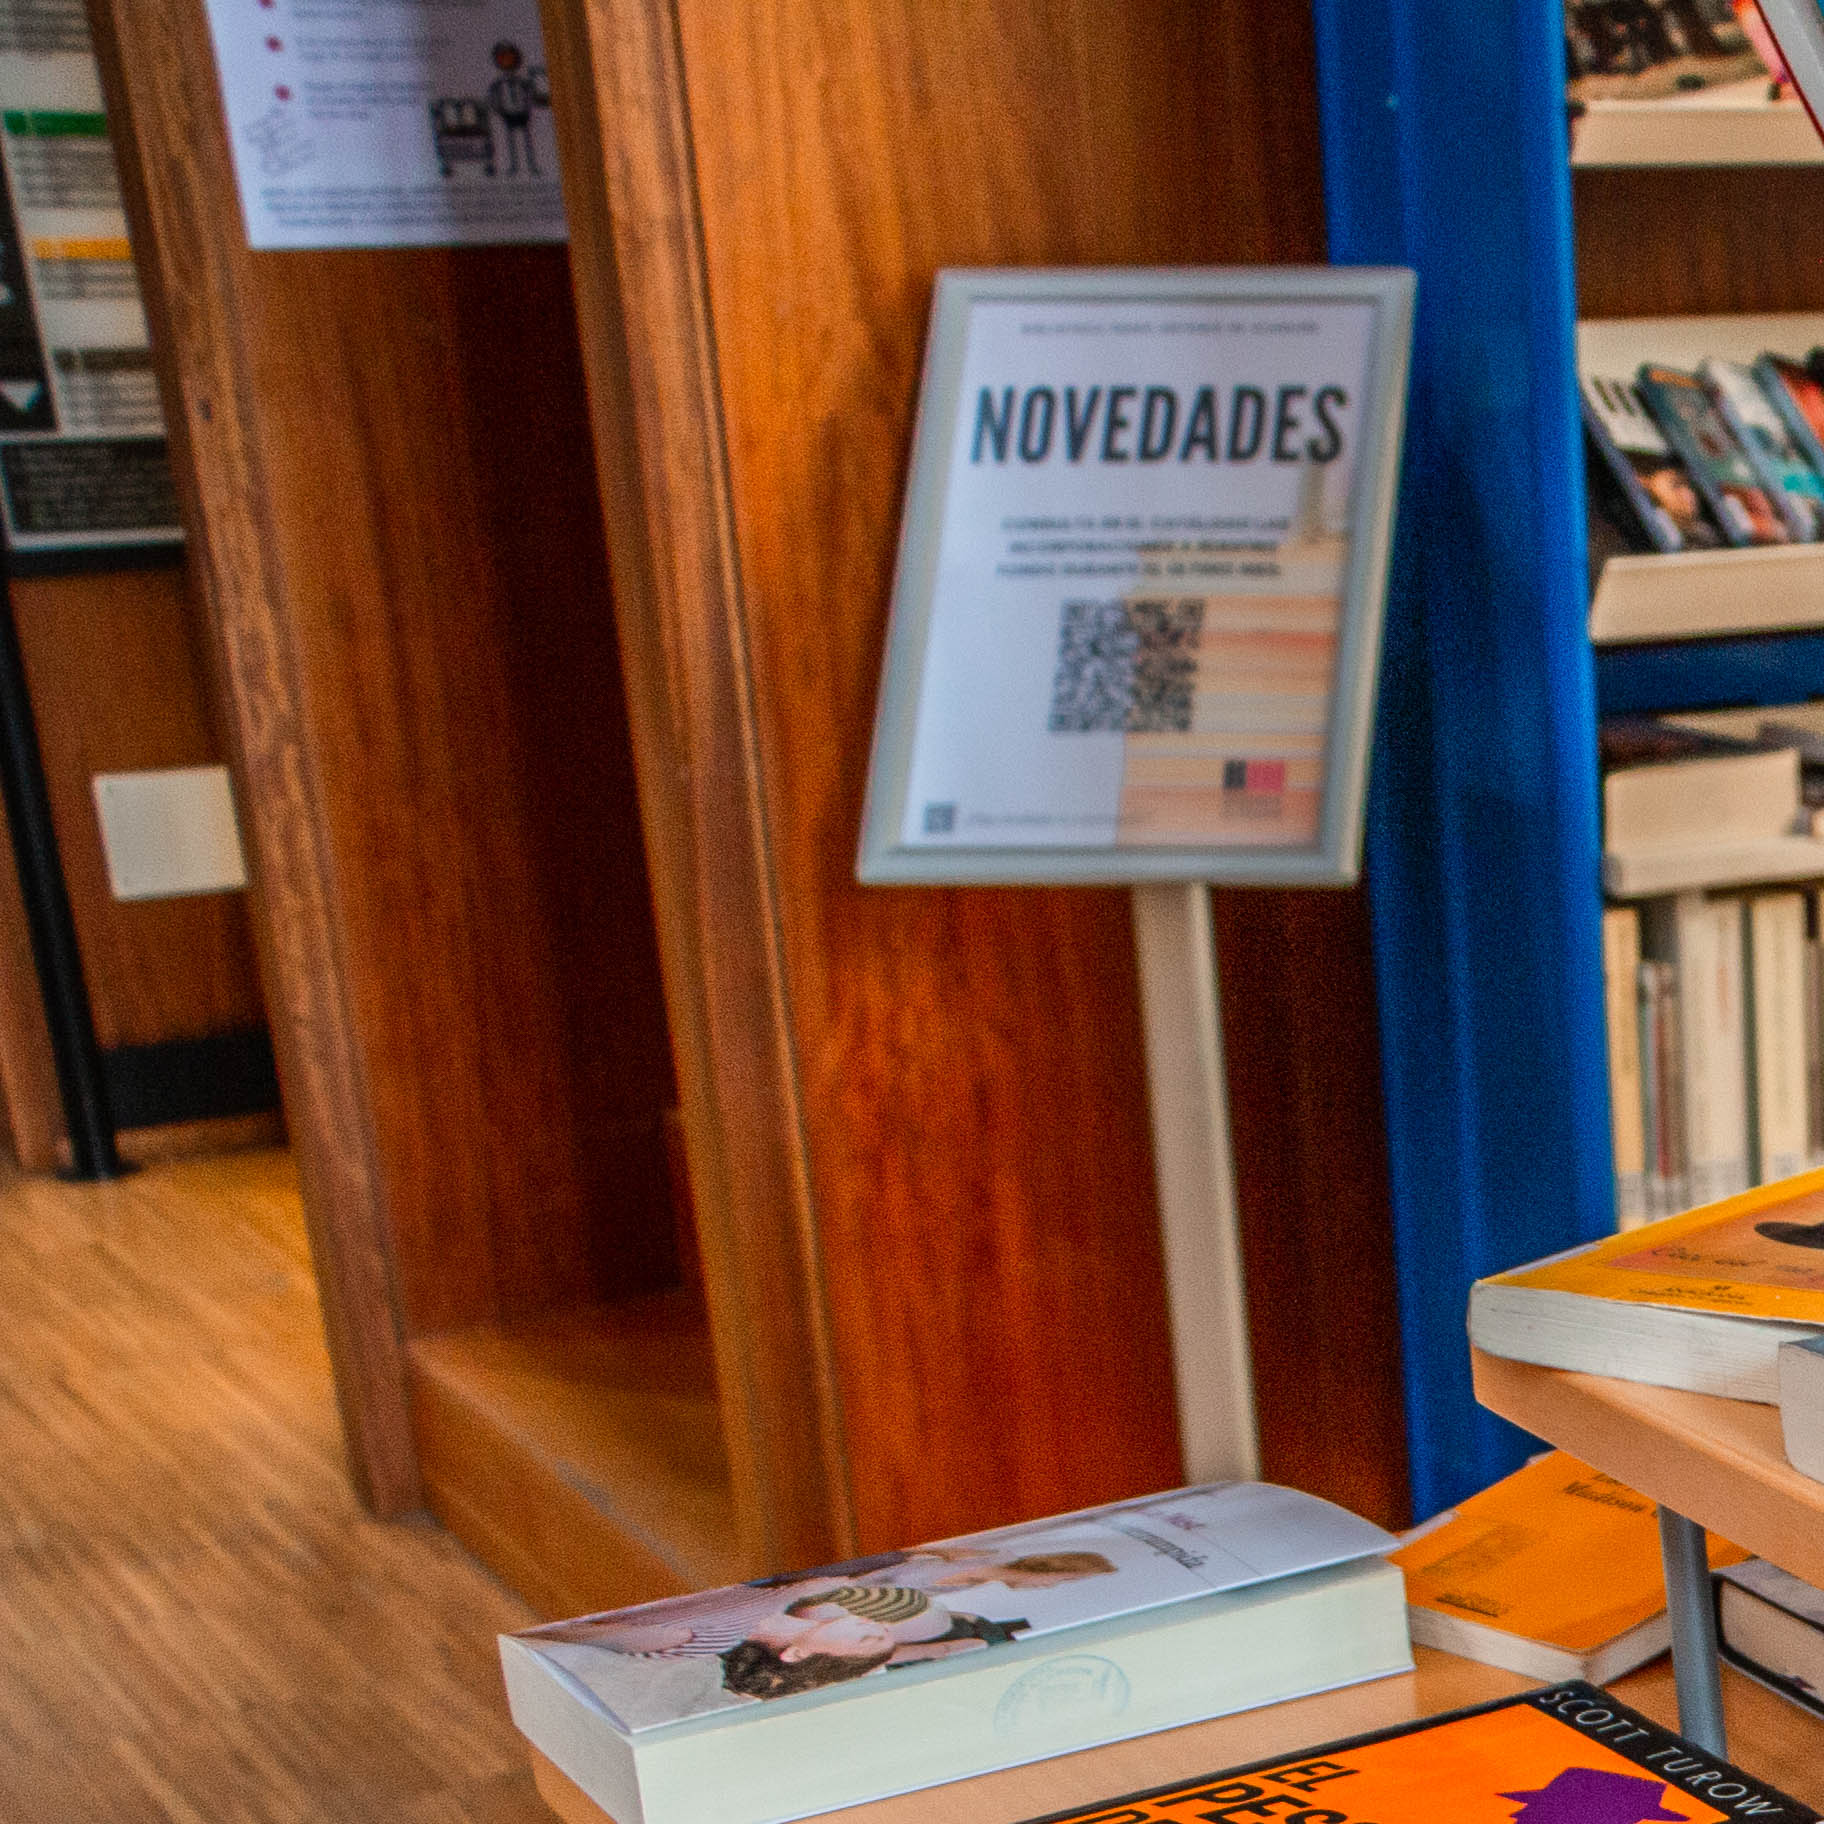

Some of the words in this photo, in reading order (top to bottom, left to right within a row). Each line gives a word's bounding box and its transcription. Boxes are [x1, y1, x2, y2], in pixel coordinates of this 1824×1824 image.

[968, 384, 1349, 468] NOVEDADES
[1261, 1760, 1363, 1794] EL
[1538, 1690, 1650, 1744] SCOTT
[1645, 1744, 1786, 1818] TUROW
